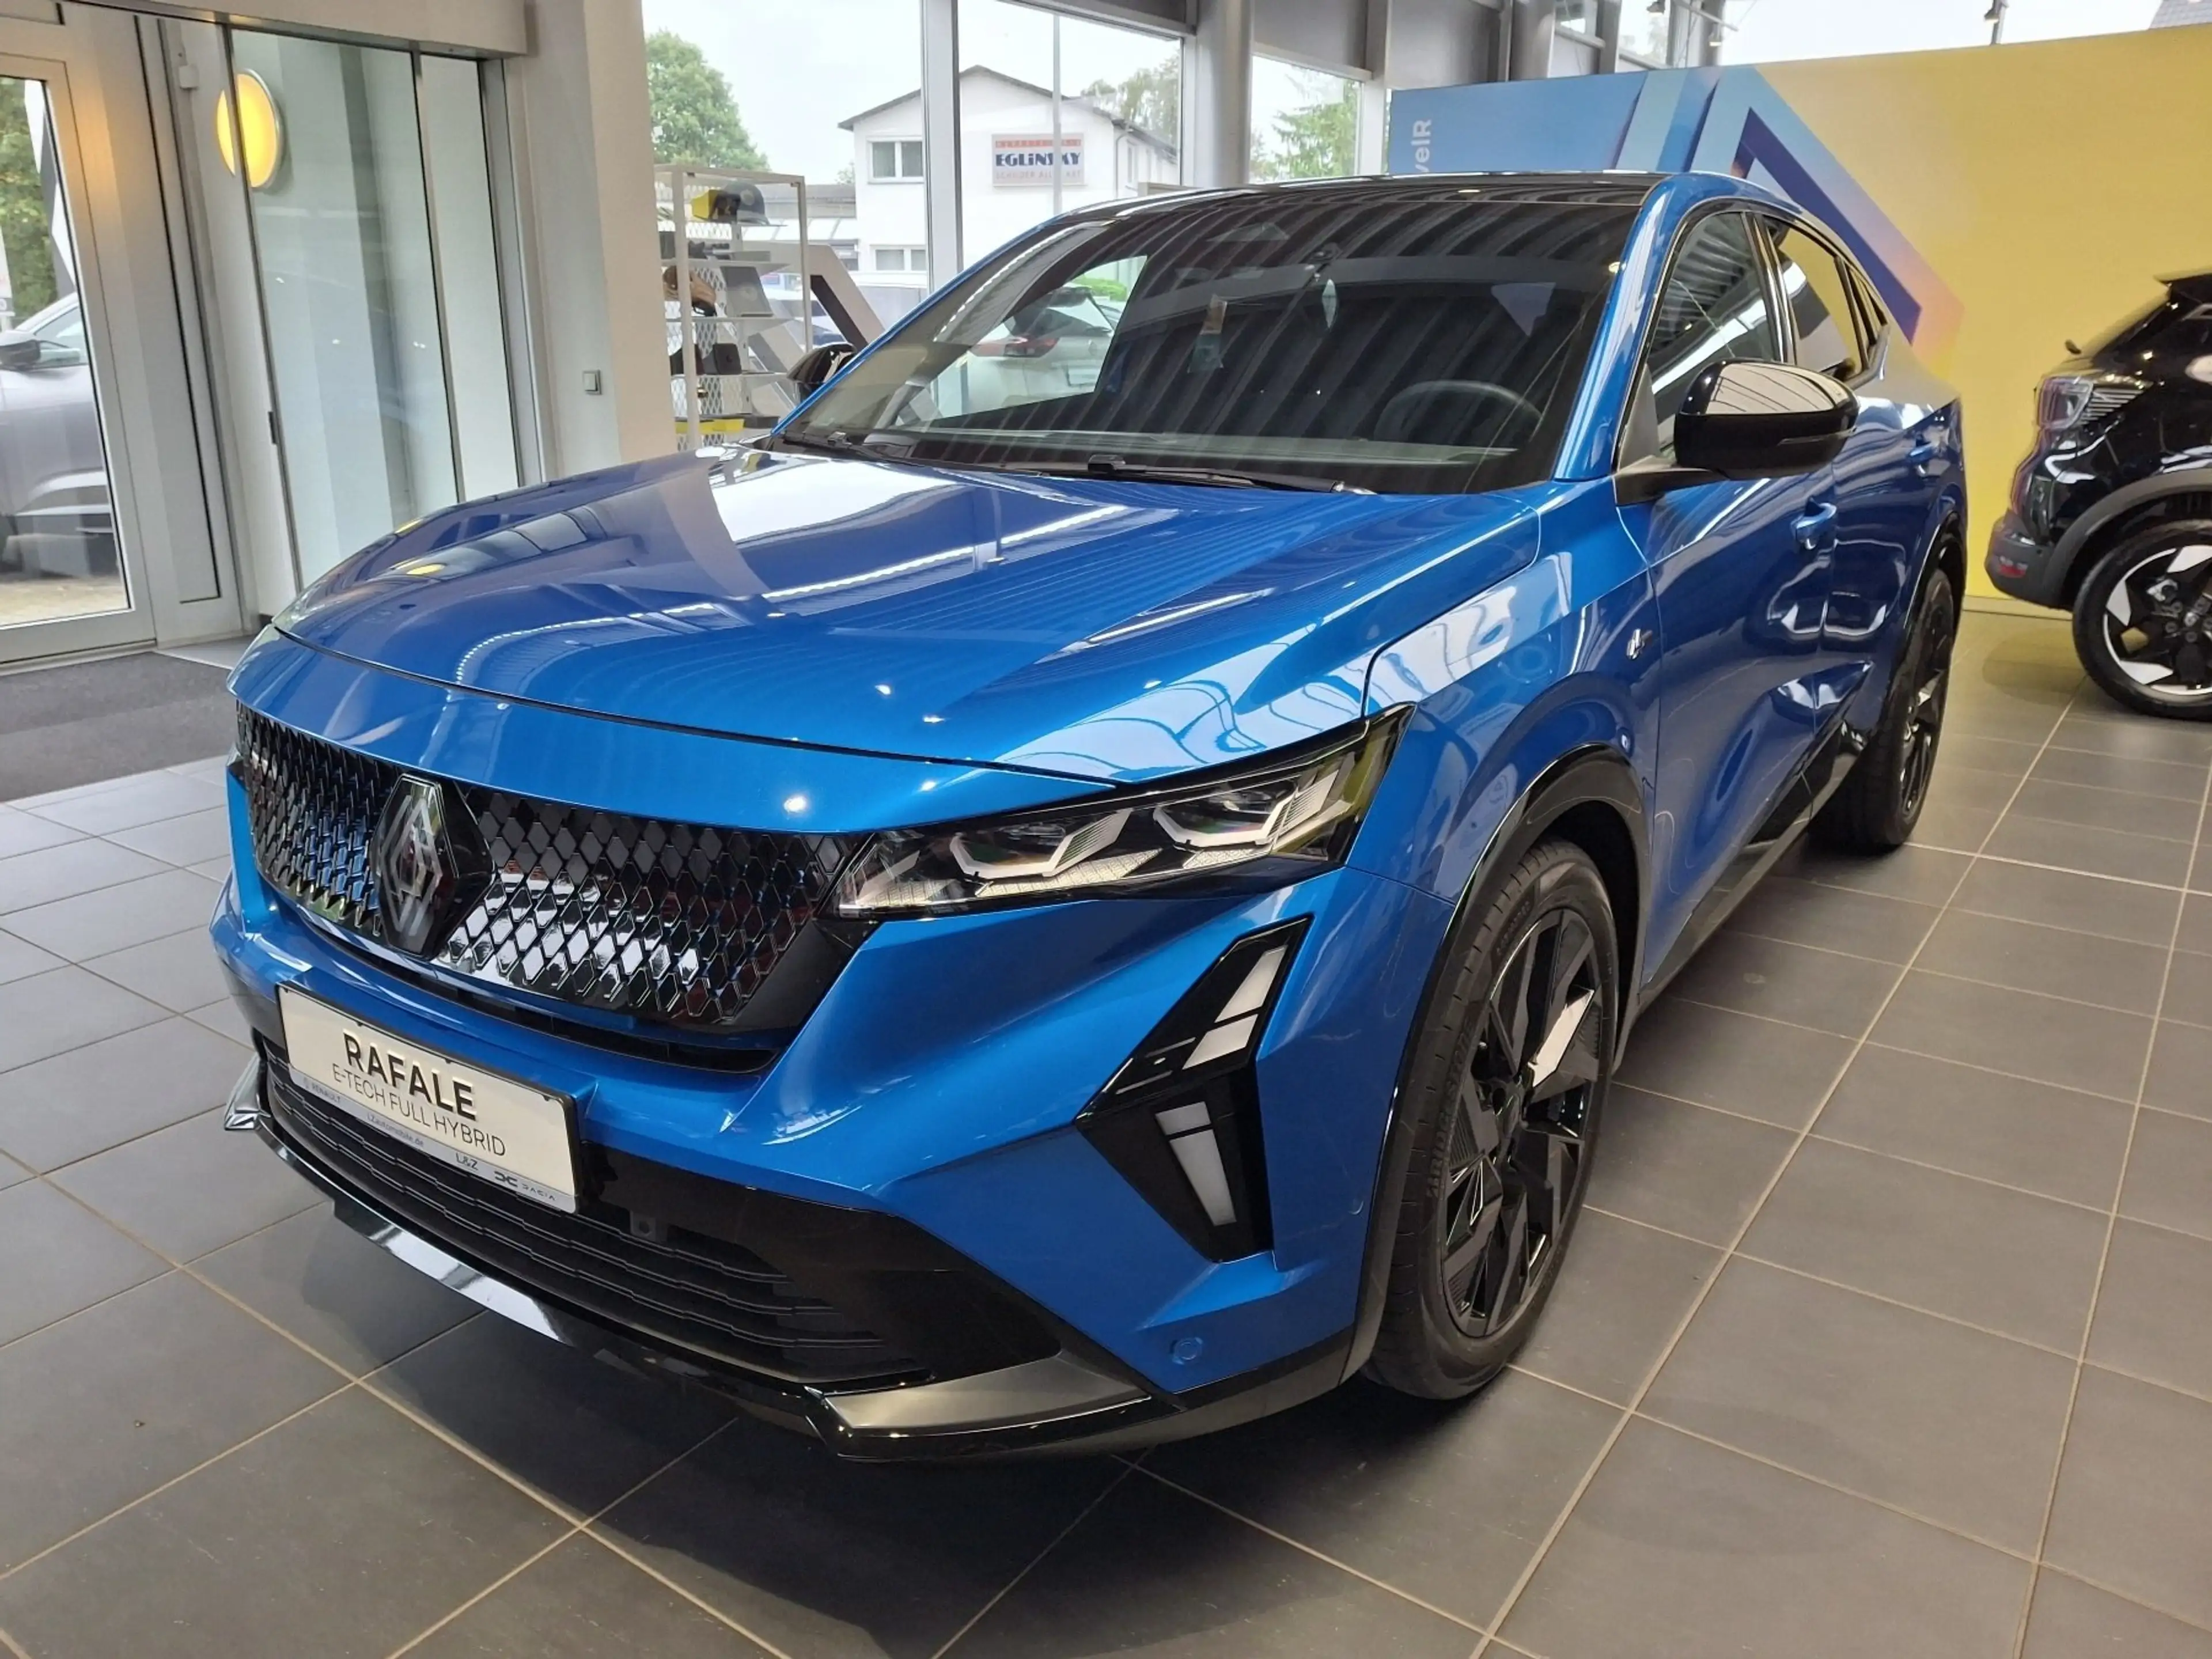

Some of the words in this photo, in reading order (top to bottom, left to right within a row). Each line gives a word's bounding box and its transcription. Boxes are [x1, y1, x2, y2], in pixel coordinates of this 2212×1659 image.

[332, 1063, 386, 1107] E-TECH
[389, 1093, 431, 1127] FULL
[434, 1112, 506, 1157] HYBRID
[343, 1032, 477, 1122] RAFALE
